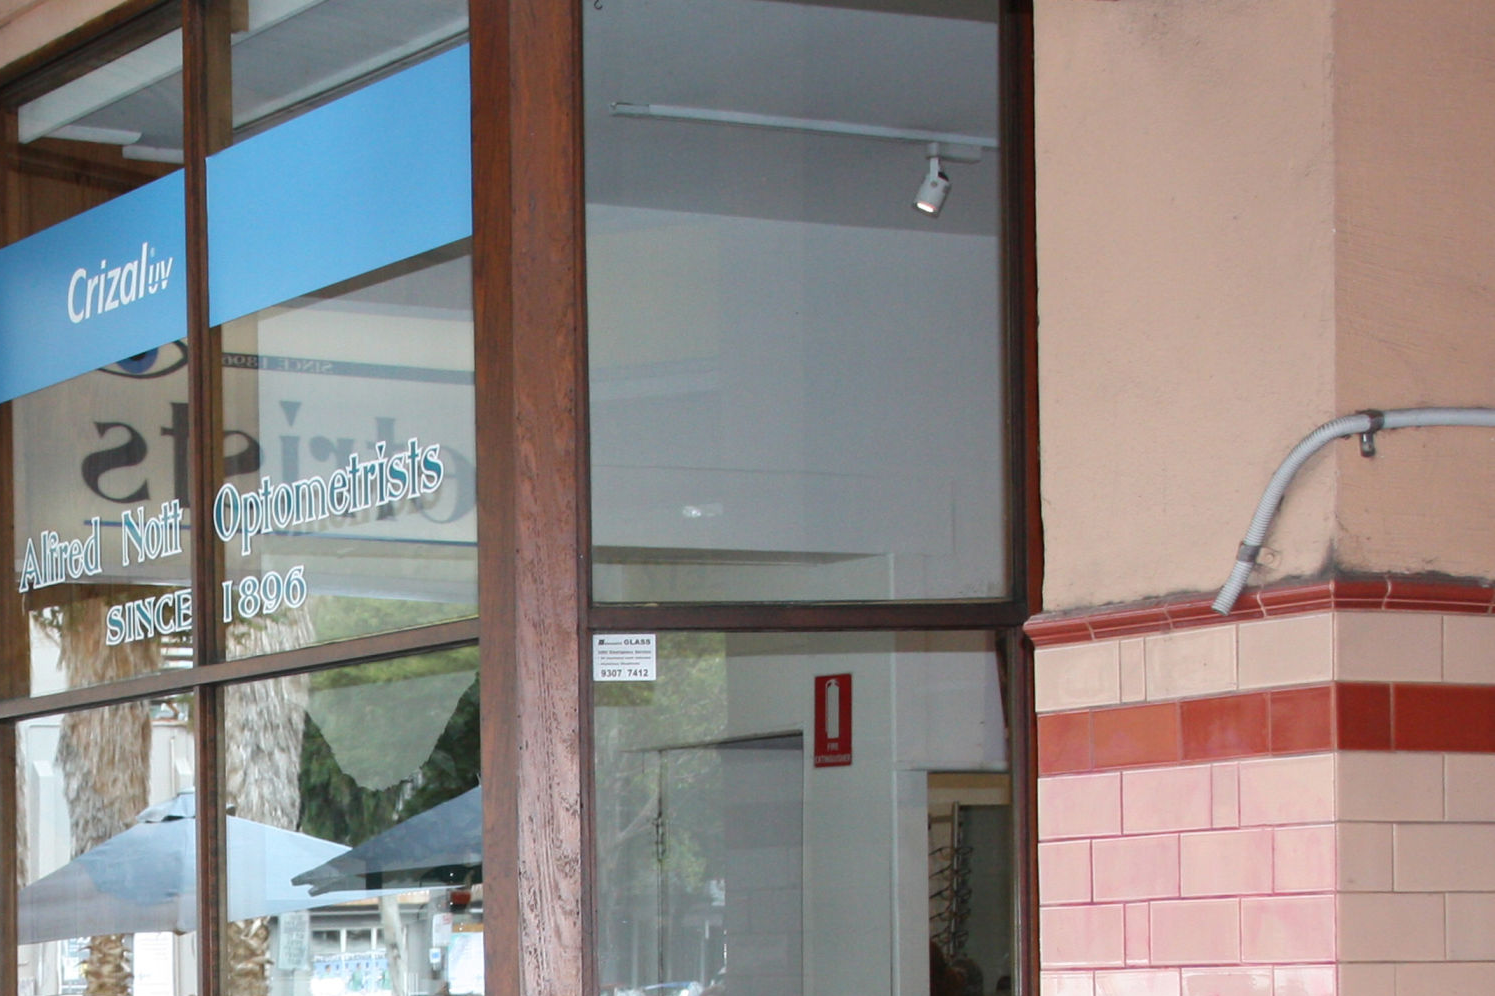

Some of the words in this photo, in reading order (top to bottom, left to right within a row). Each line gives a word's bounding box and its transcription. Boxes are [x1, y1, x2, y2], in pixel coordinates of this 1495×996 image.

[67, 242, 148, 324] Crizal
[19, 517, 102, 593] Alfred
[122, 499, 182, 566] Nott
[214, 437, 444, 555] Optometrists
[106, 589, 192, 646] SINCE
[222, 565, 307, 623] 1896
[600, 669, 622, 677] 9307
[627, 669, 649, 677] 7412
